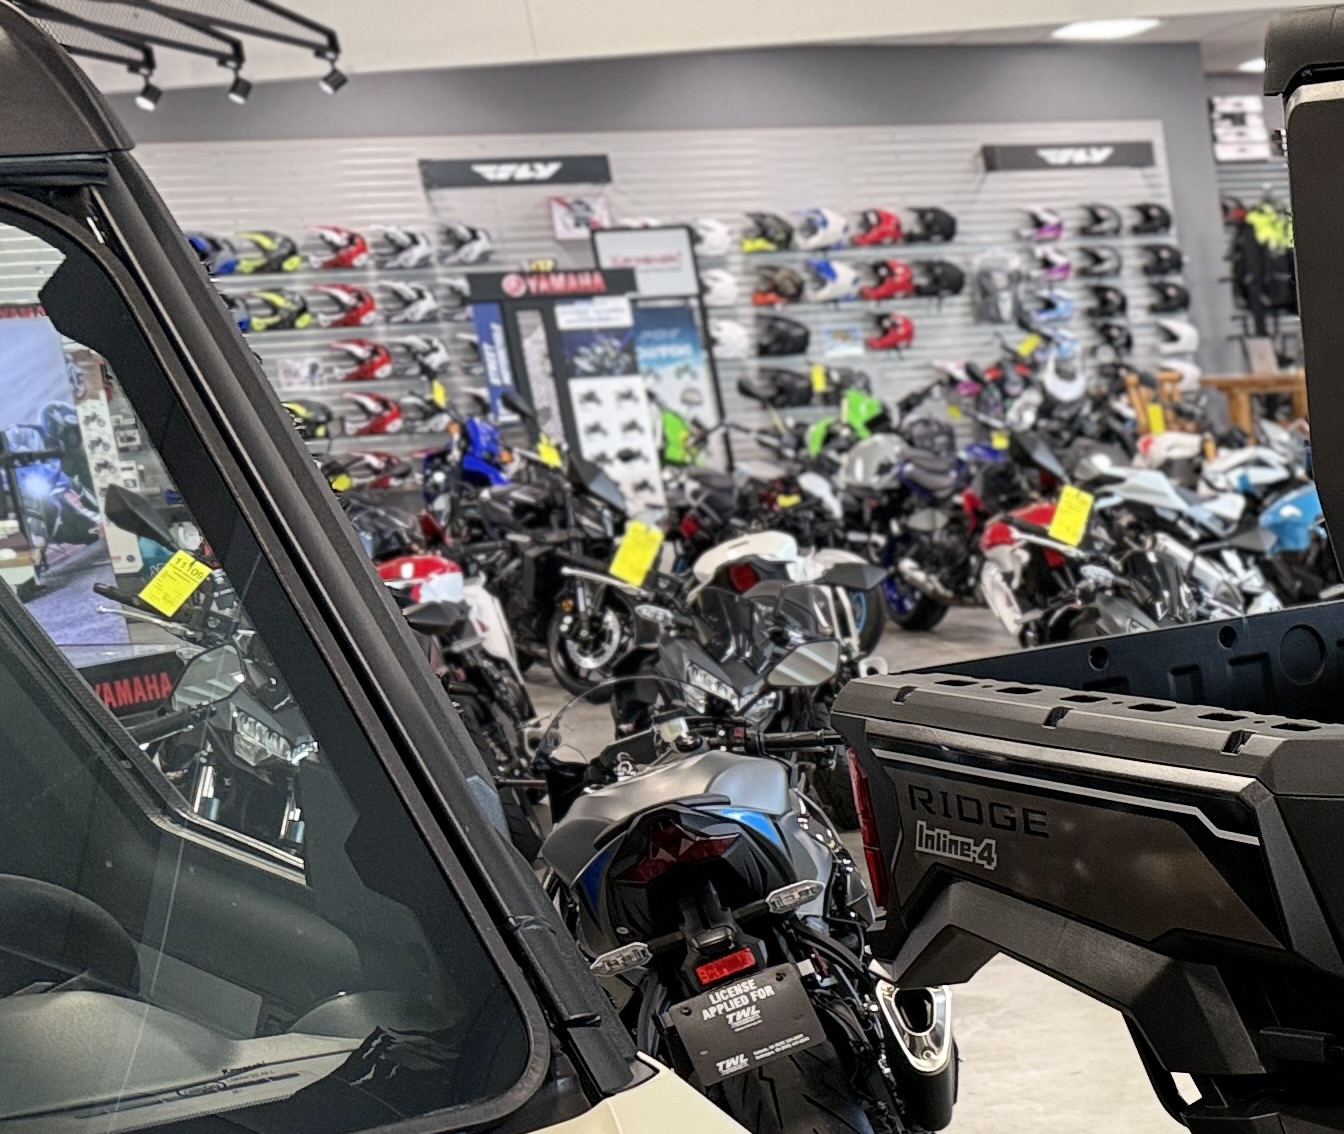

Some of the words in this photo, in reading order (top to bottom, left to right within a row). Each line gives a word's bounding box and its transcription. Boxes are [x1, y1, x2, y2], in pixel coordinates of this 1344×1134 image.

[526, 272, 606, 294] YAMAHA
[908, 784, 1050, 839] RIDGE
[702, 997, 750, 1020] APPLIED
[752, 985, 775, 1004] FOR
[708, 979, 758, 1004] LICENSE
[725, 1005, 761, 1025] TWL
[716, 1053, 749, 1072] TWL
